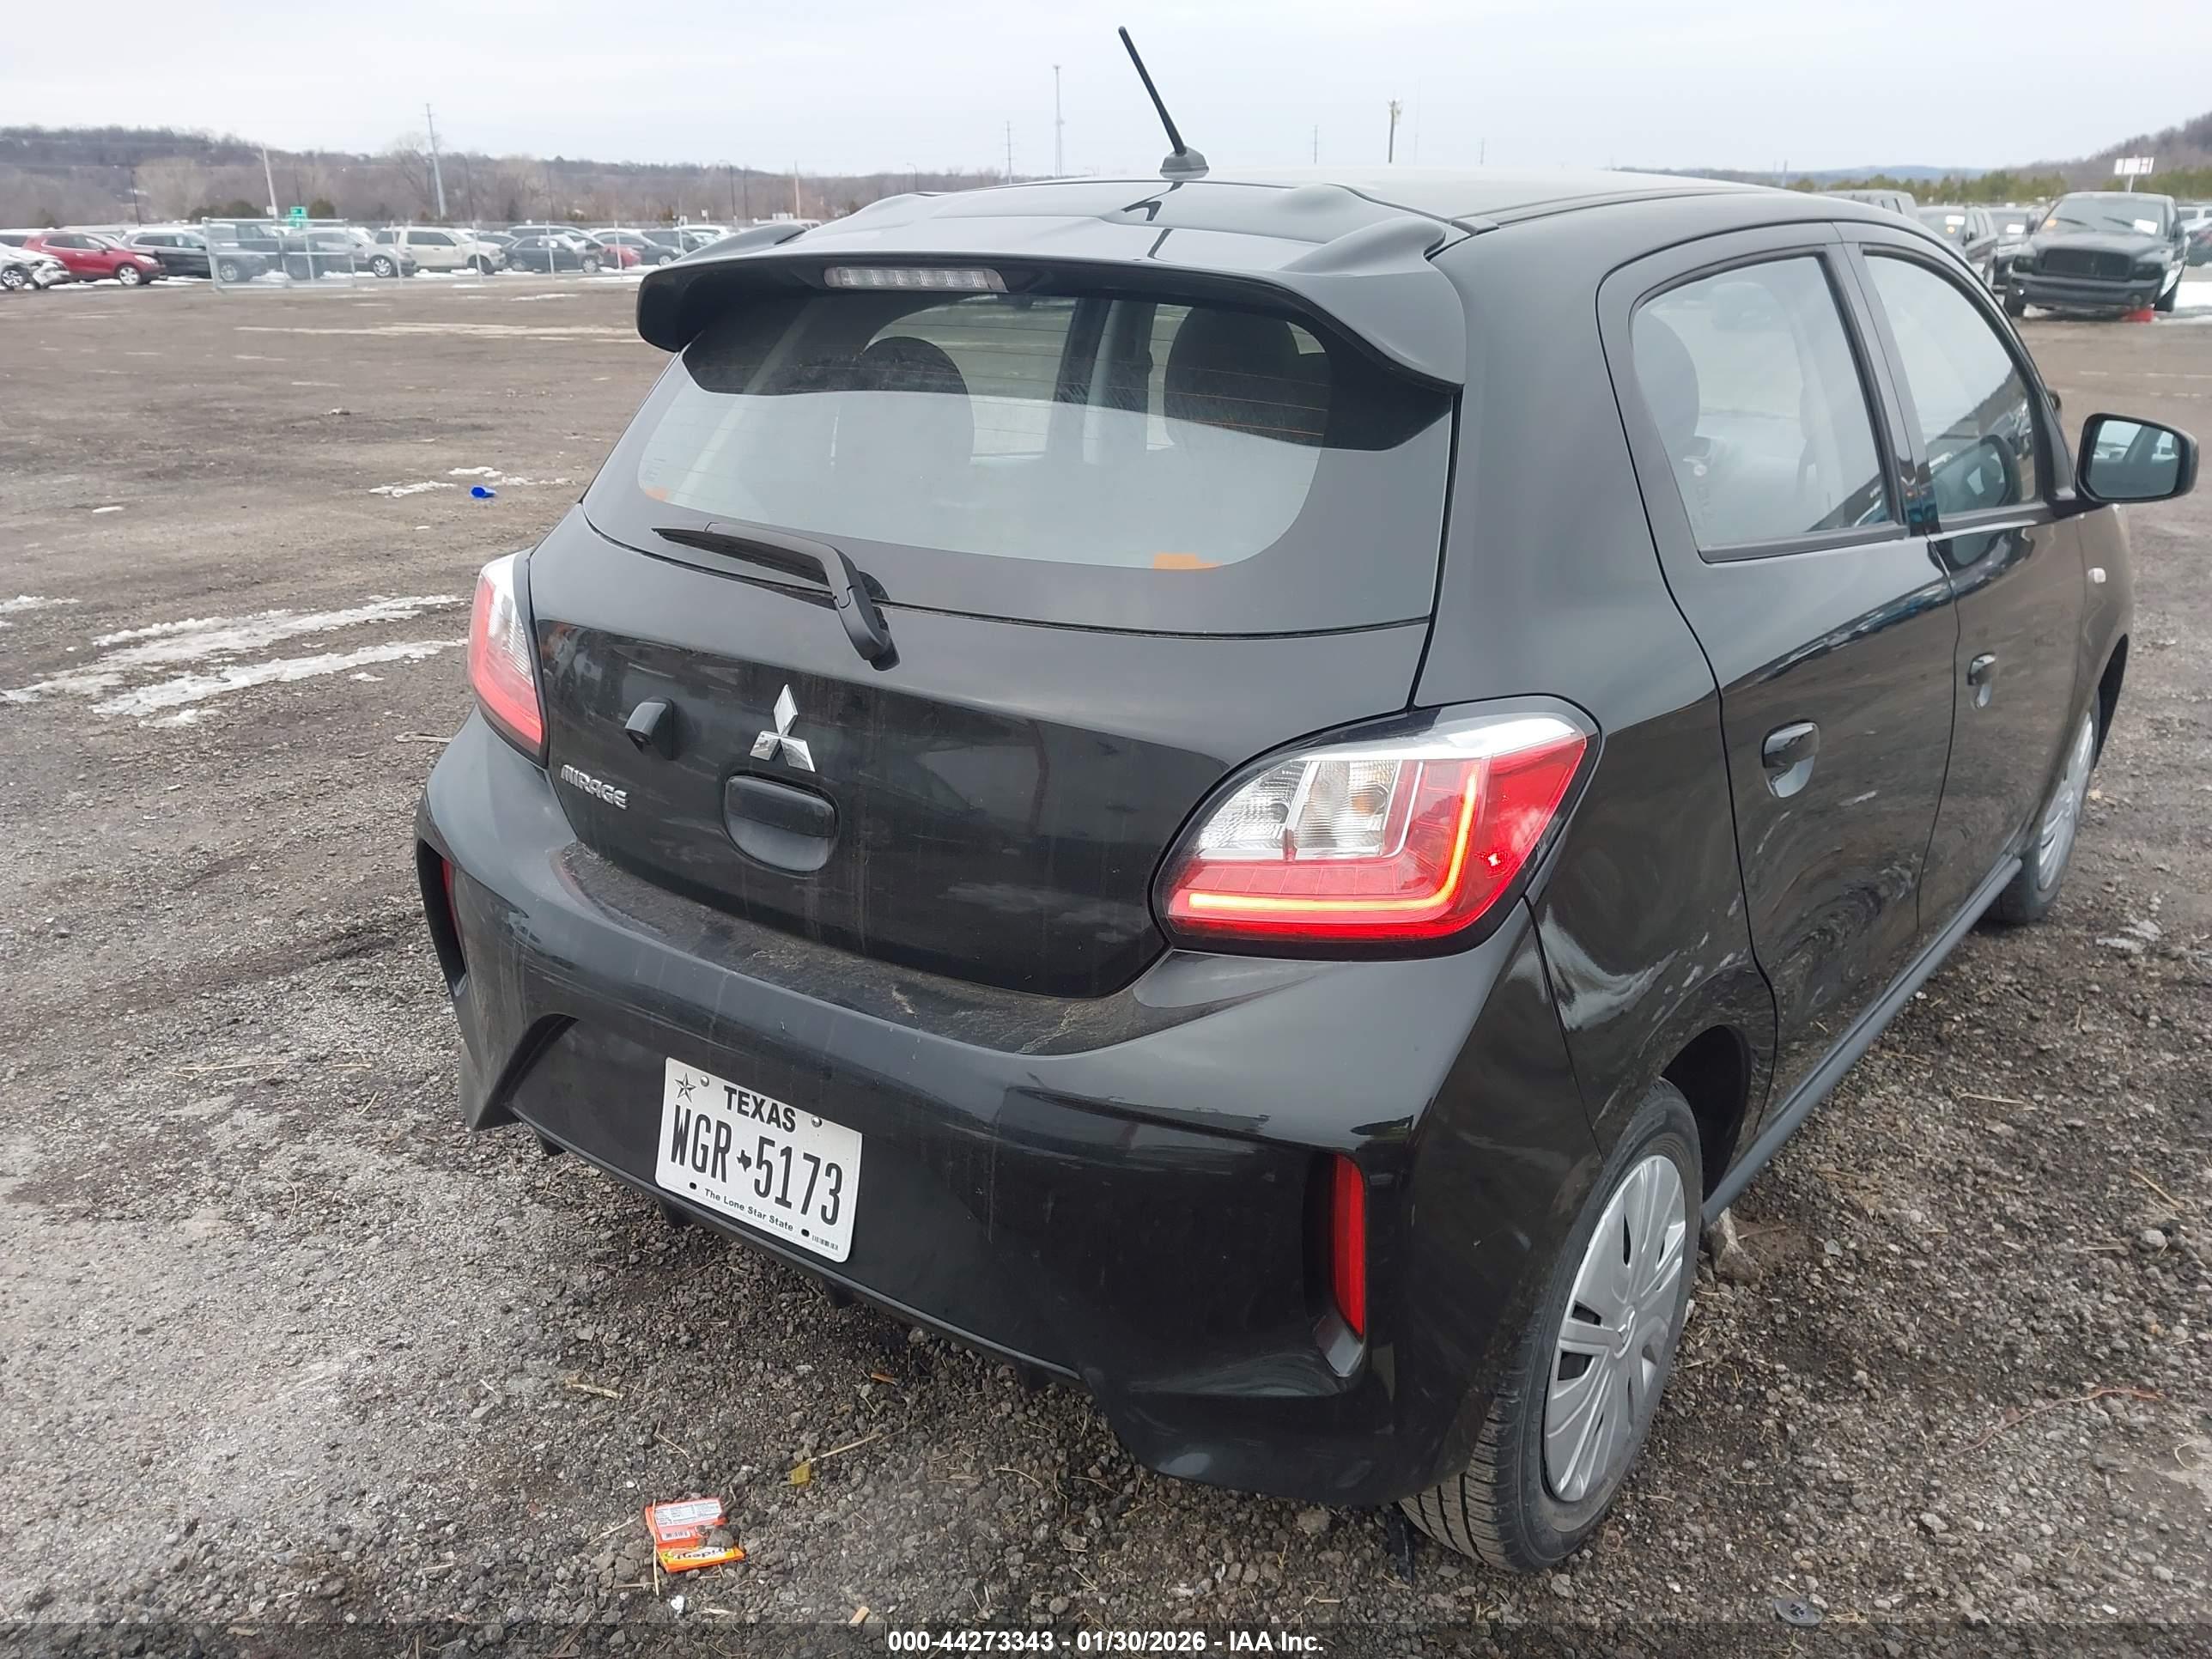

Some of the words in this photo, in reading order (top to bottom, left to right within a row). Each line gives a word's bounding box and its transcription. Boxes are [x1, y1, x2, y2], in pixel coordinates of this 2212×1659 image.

[560, 763, 628, 811] MIRAGE
[723, 1085, 796, 1133] TEXAS
[671, 1104, 732, 1183] WGR
[754, 1135, 842, 1226] 5173
[704, 1188, 721, 1202] The
[723, 1196, 744, 1212] Lone
[748, 1206, 767, 1220] Star
[769, 1215, 793, 1231] State
